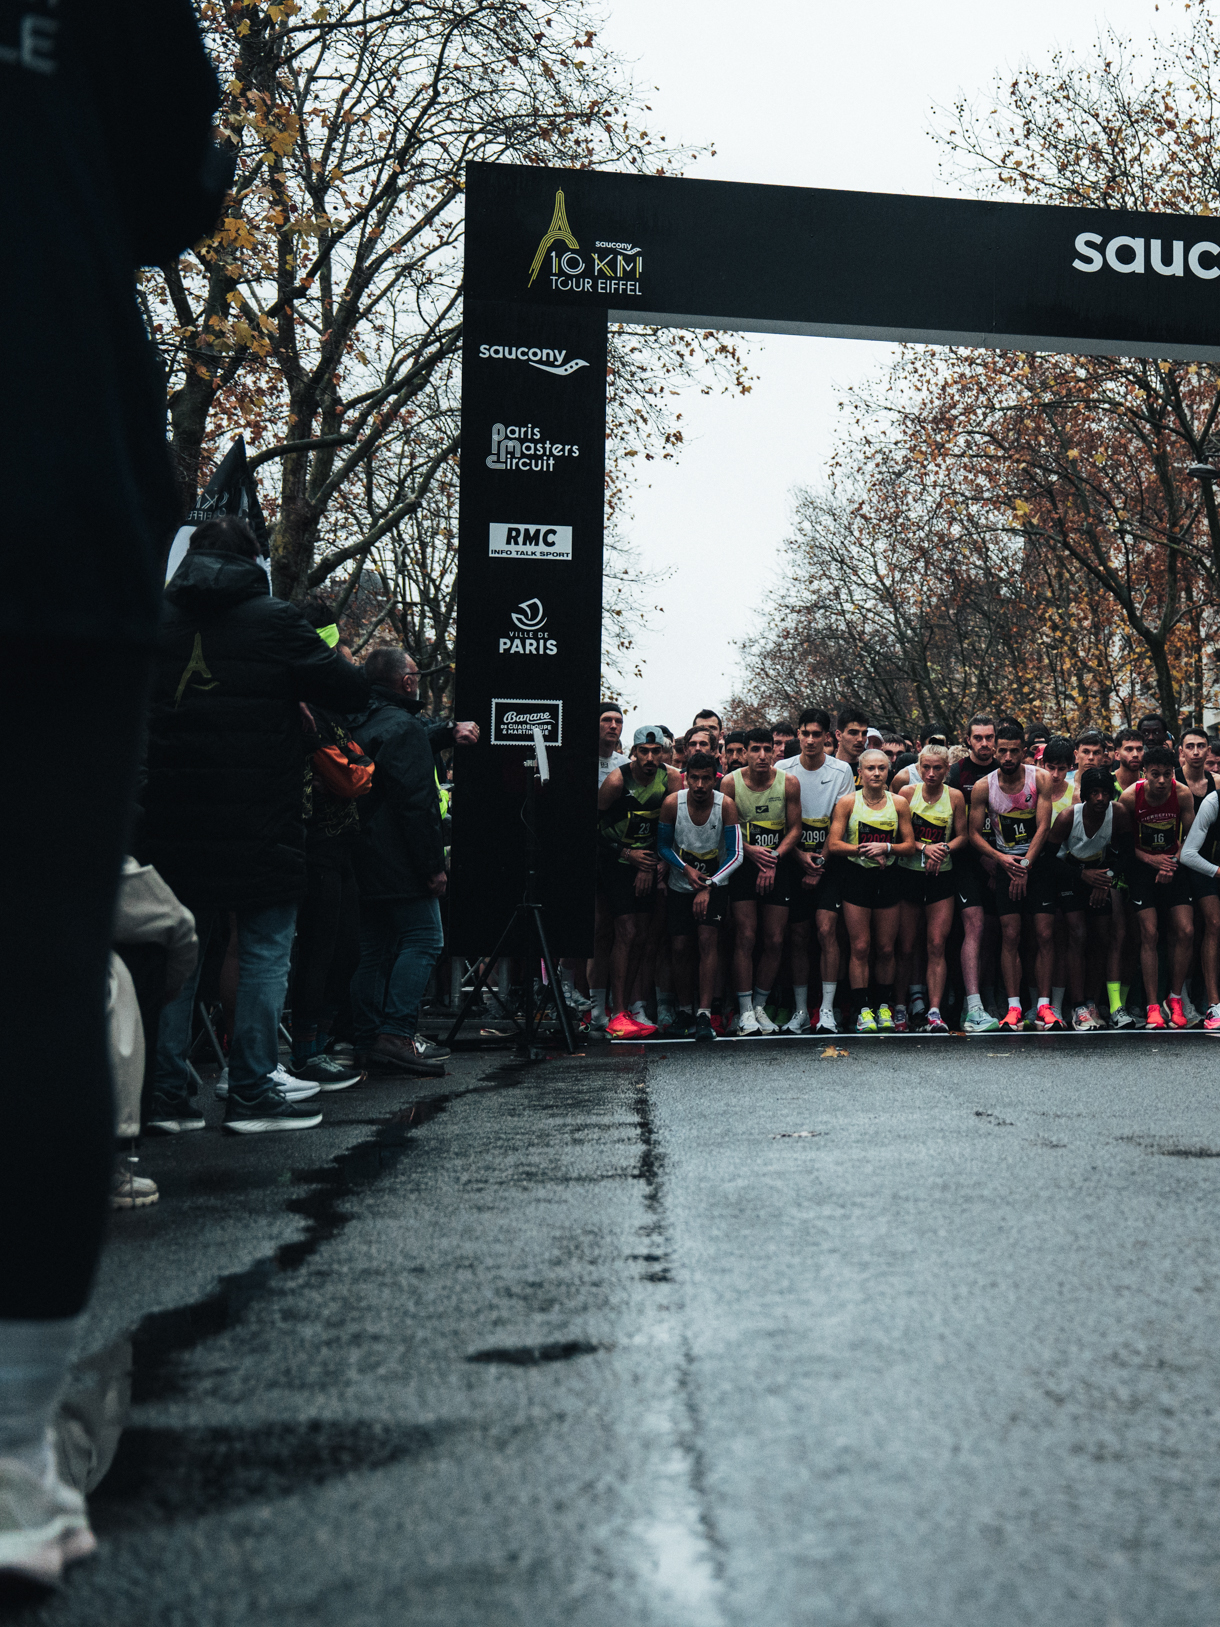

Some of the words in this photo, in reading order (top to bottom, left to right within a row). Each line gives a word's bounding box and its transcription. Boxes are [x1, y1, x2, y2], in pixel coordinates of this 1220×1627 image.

[595, 240, 633, 250] saucony
[550, 251, 585, 275] 10
[591, 252, 642, 278] KM
[550, 276, 593, 292] TOUR
[598, 279, 642, 295] EIFFEL
[478, 344, 567, 366] saucony
[505, 526, 558, 548] RMC
[490, 549, 512, 557] INFO
[539, 551, 571, 559] SPORT
[499, 638, 558, 655] PARIS
[503, 711, 555, 724] Banane
[638, 822, 651, 834] 23
[1013, 822, 1026, 835] 14
[755, 832, 779, 847] 3004
[1153, 833, 1165, 843] 16
